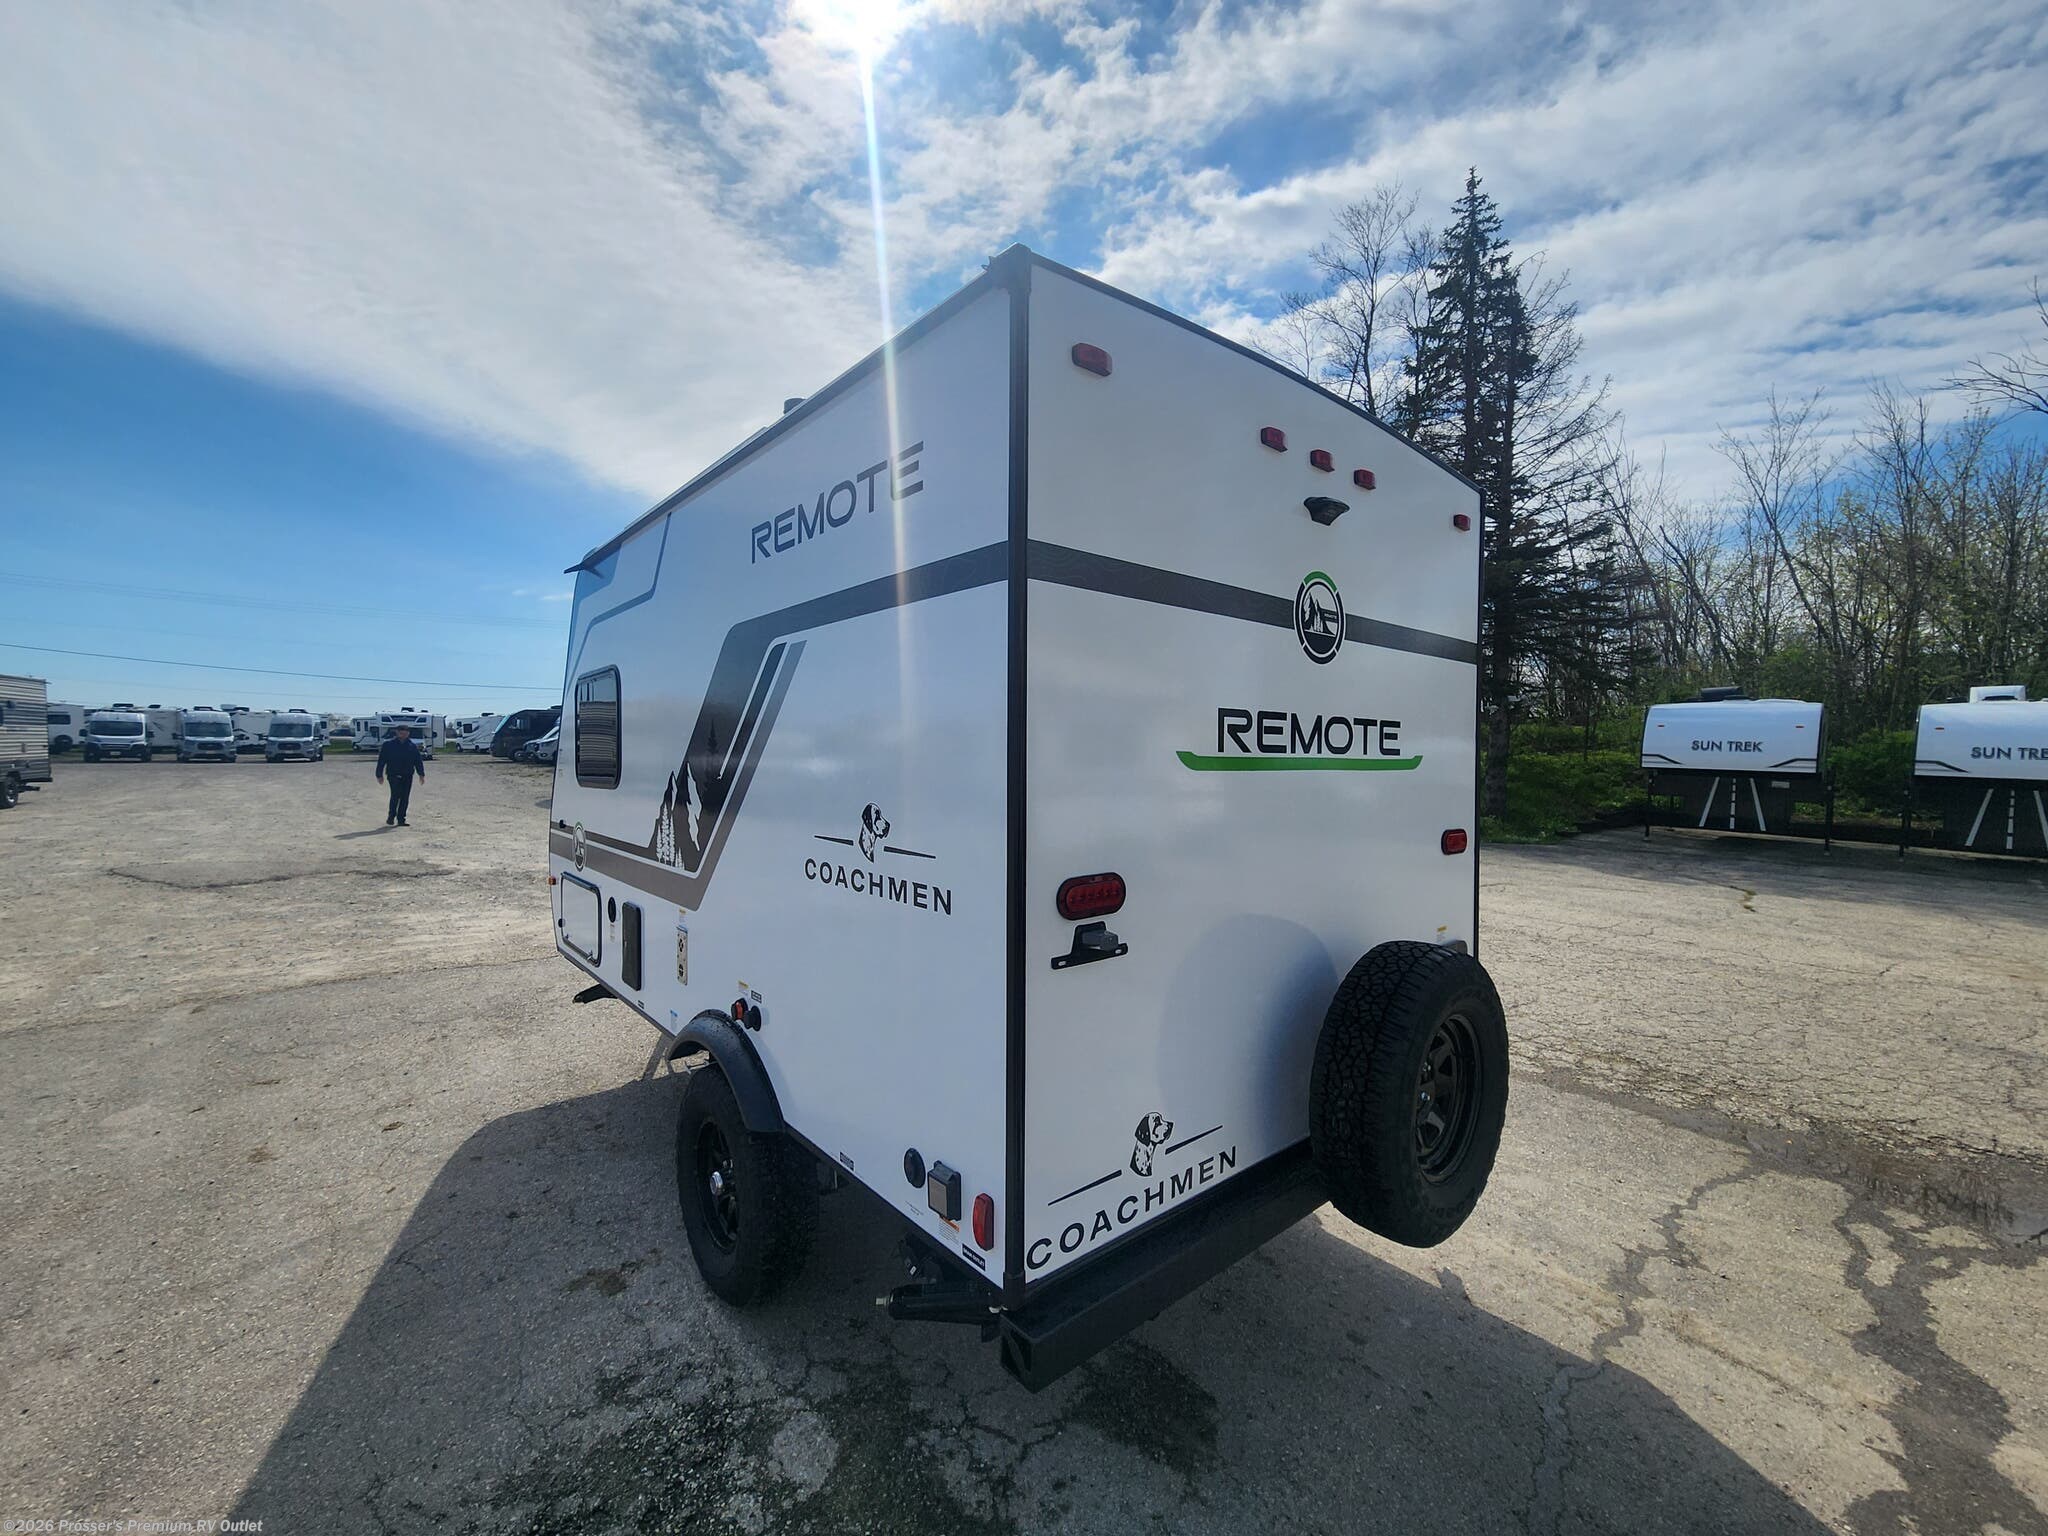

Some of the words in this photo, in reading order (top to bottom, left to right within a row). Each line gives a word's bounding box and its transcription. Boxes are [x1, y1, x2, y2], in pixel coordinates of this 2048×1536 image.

[751, 440, 924, 565] REMOTE
[1217, 707, 1401, 756] REMOTE
[1691, 740, 1722, 752] SUN
[1727, 740, 1764, 753] TREK
[1971, 746, 2011, 760] SUN
[804, 858, 952, 916] COACHMEN
[1026, 1146, 1237, 1270] COACHMEN
